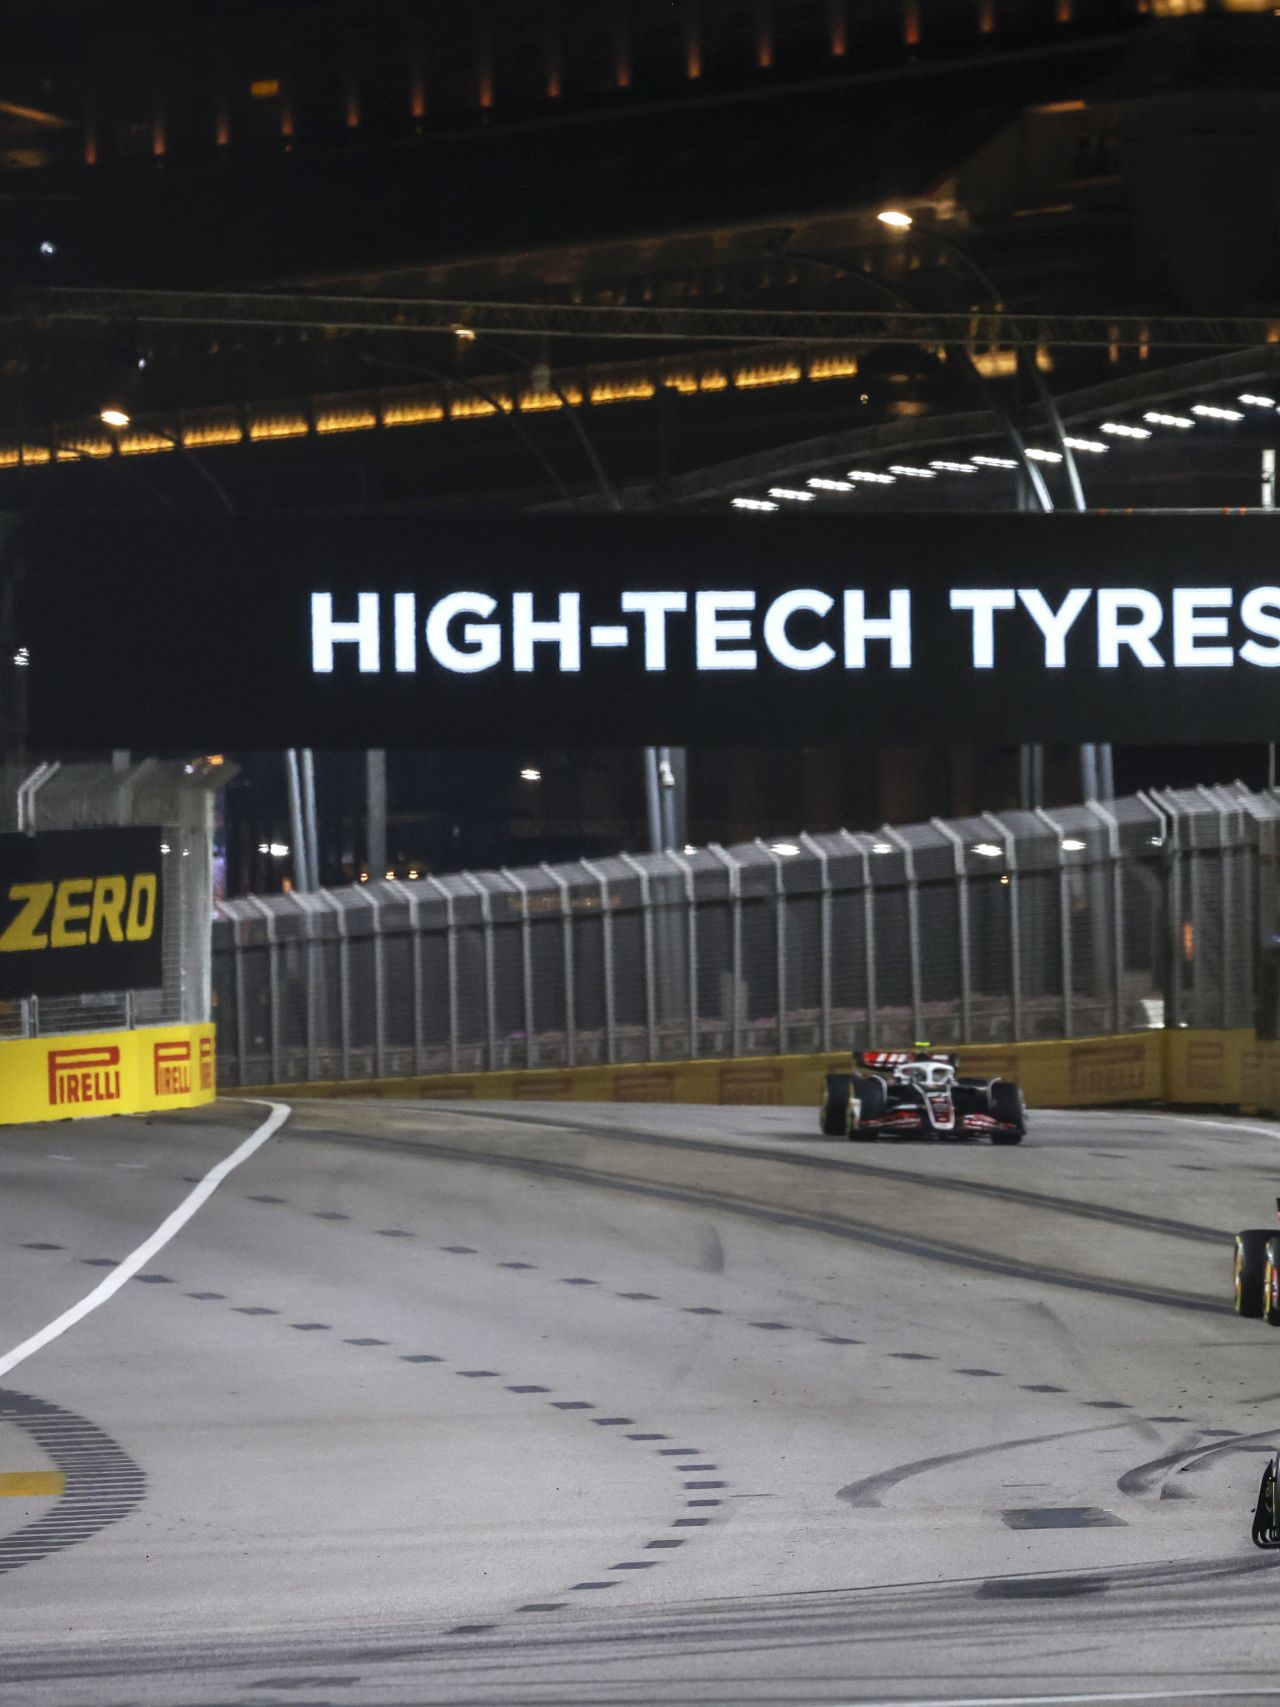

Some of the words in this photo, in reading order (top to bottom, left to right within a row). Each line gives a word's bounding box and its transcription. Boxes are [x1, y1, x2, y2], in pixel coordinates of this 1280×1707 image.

[311, 590, 912, 675] HIGH-TECH
[0, 872, 157, 952] ZERO
[48, 1045, 121, 1105] PIRELLI
